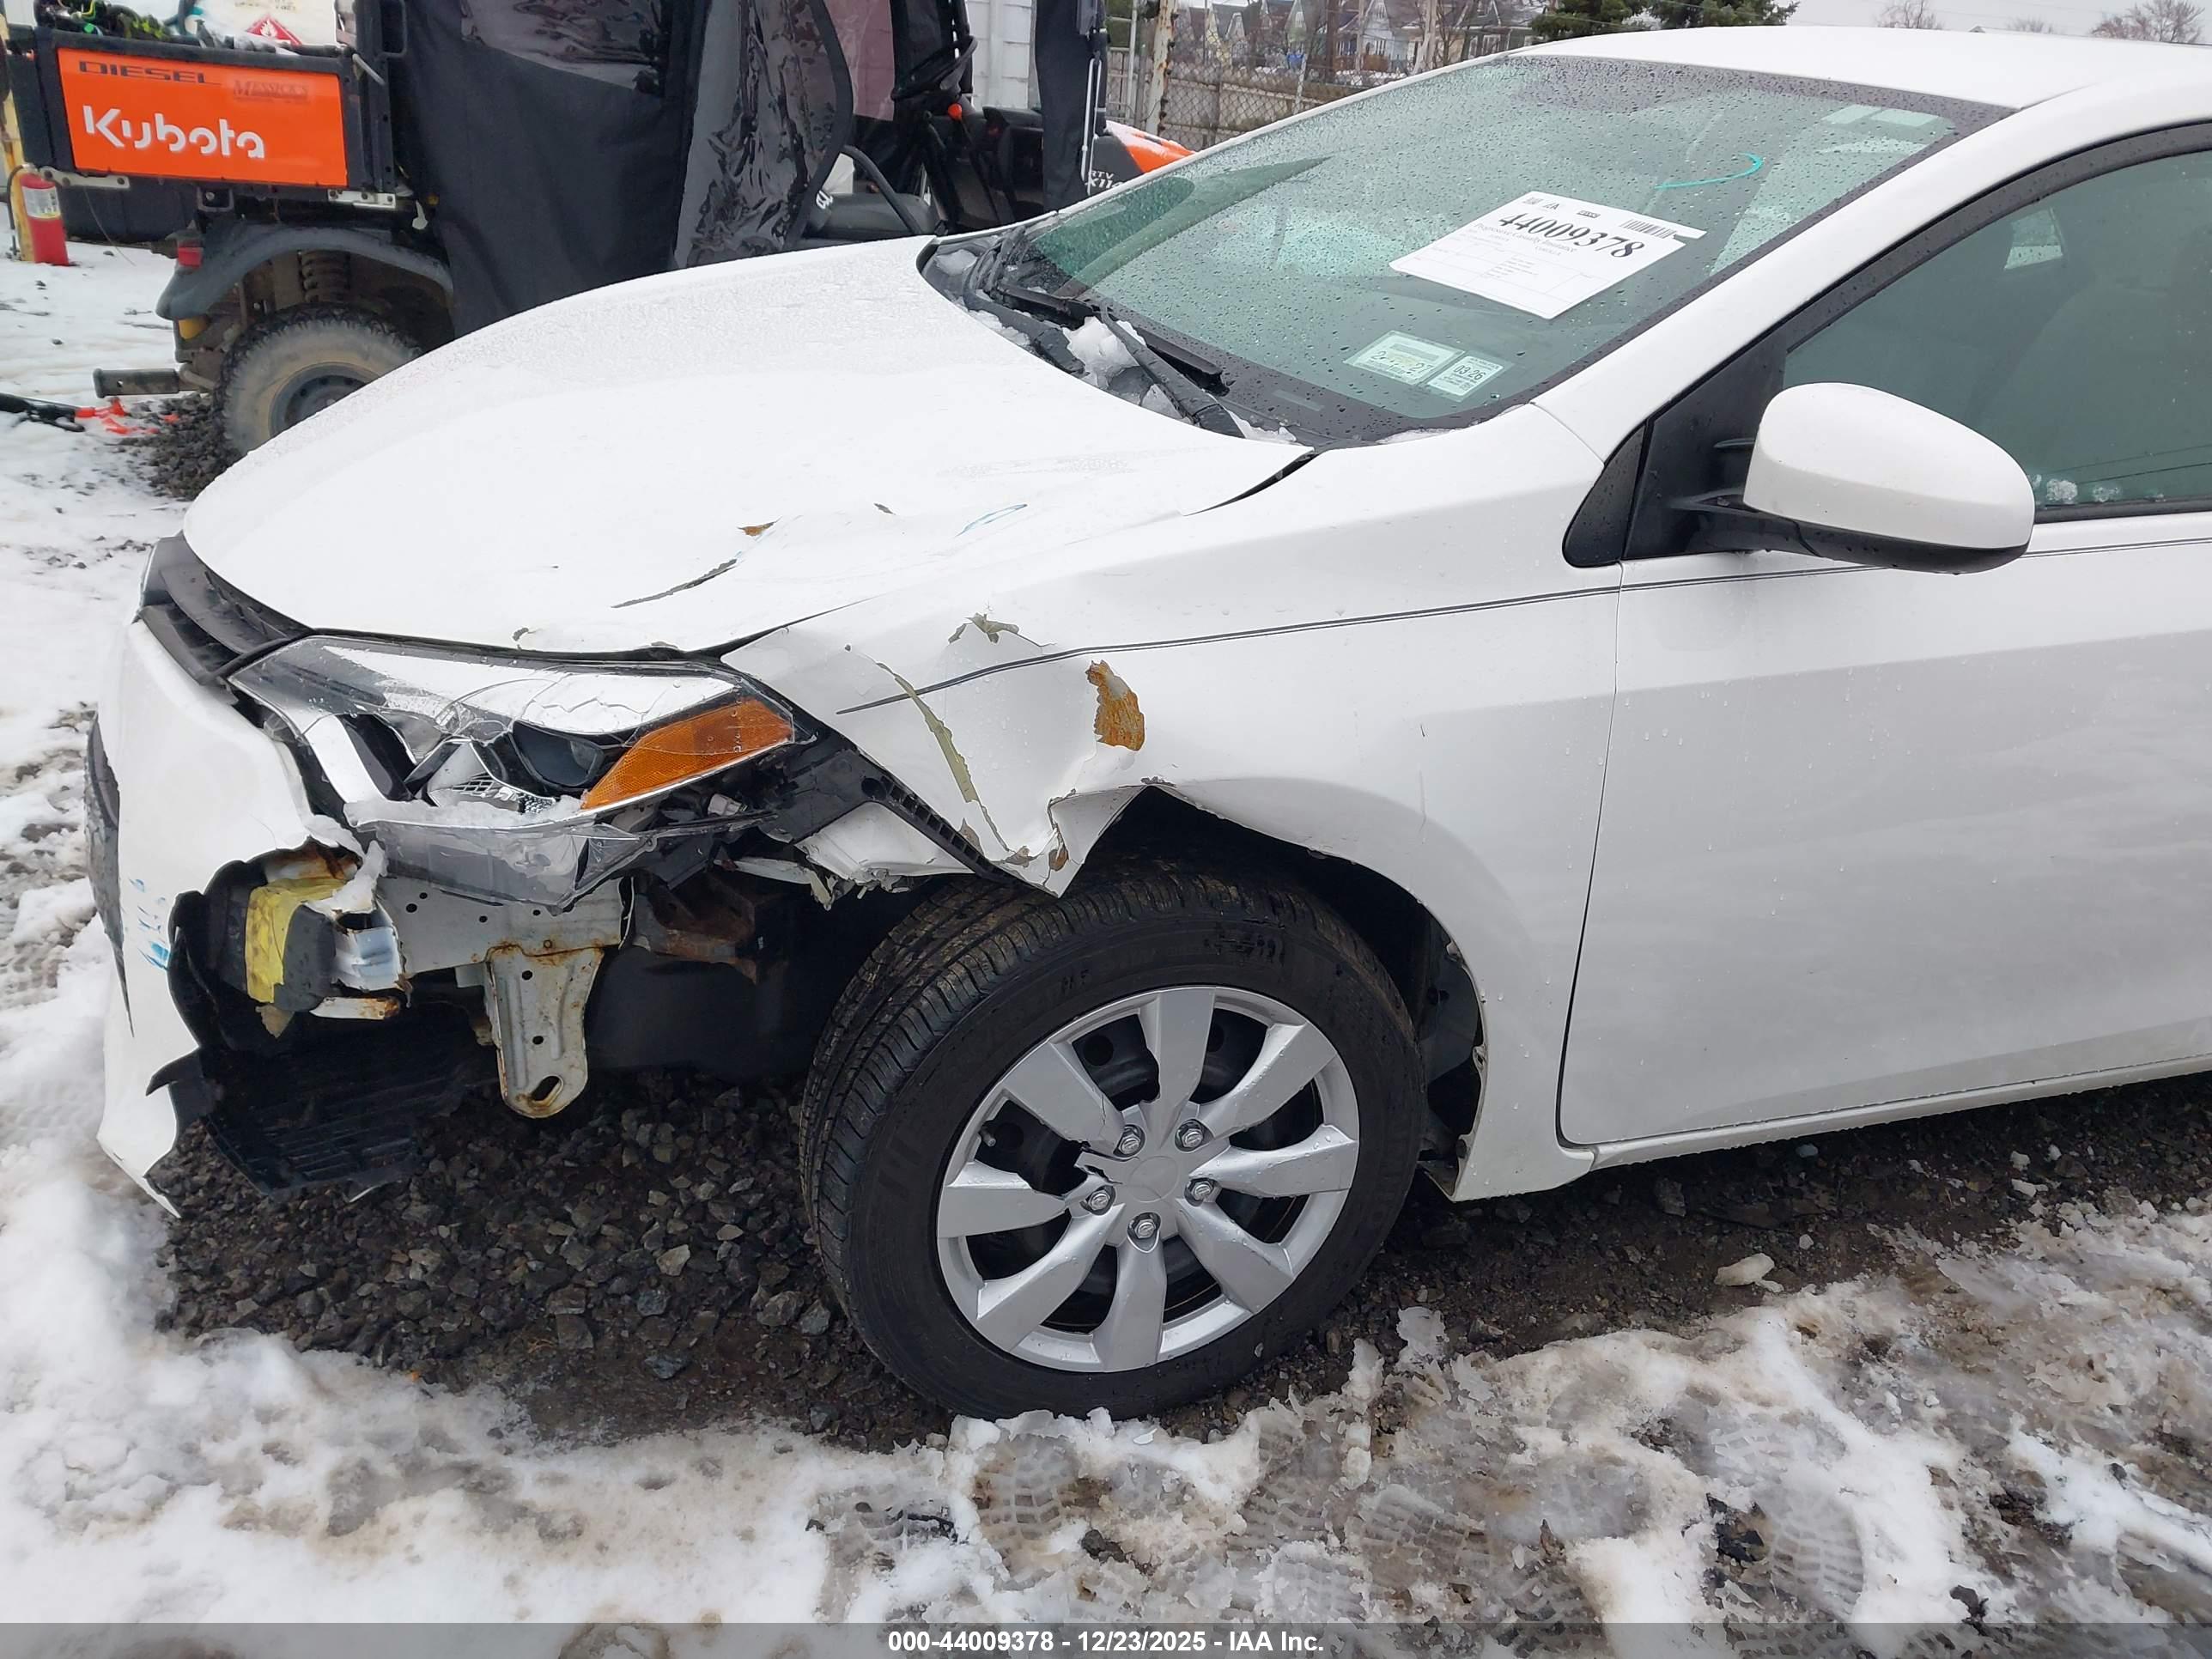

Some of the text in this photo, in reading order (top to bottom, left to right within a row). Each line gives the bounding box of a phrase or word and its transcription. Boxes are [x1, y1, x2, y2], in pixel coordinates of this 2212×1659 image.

[79, 60, 222, 86] DIESEL
[82, 105, 265, 160] Kubota
[1498, 212, 1645, 258] 44009378
